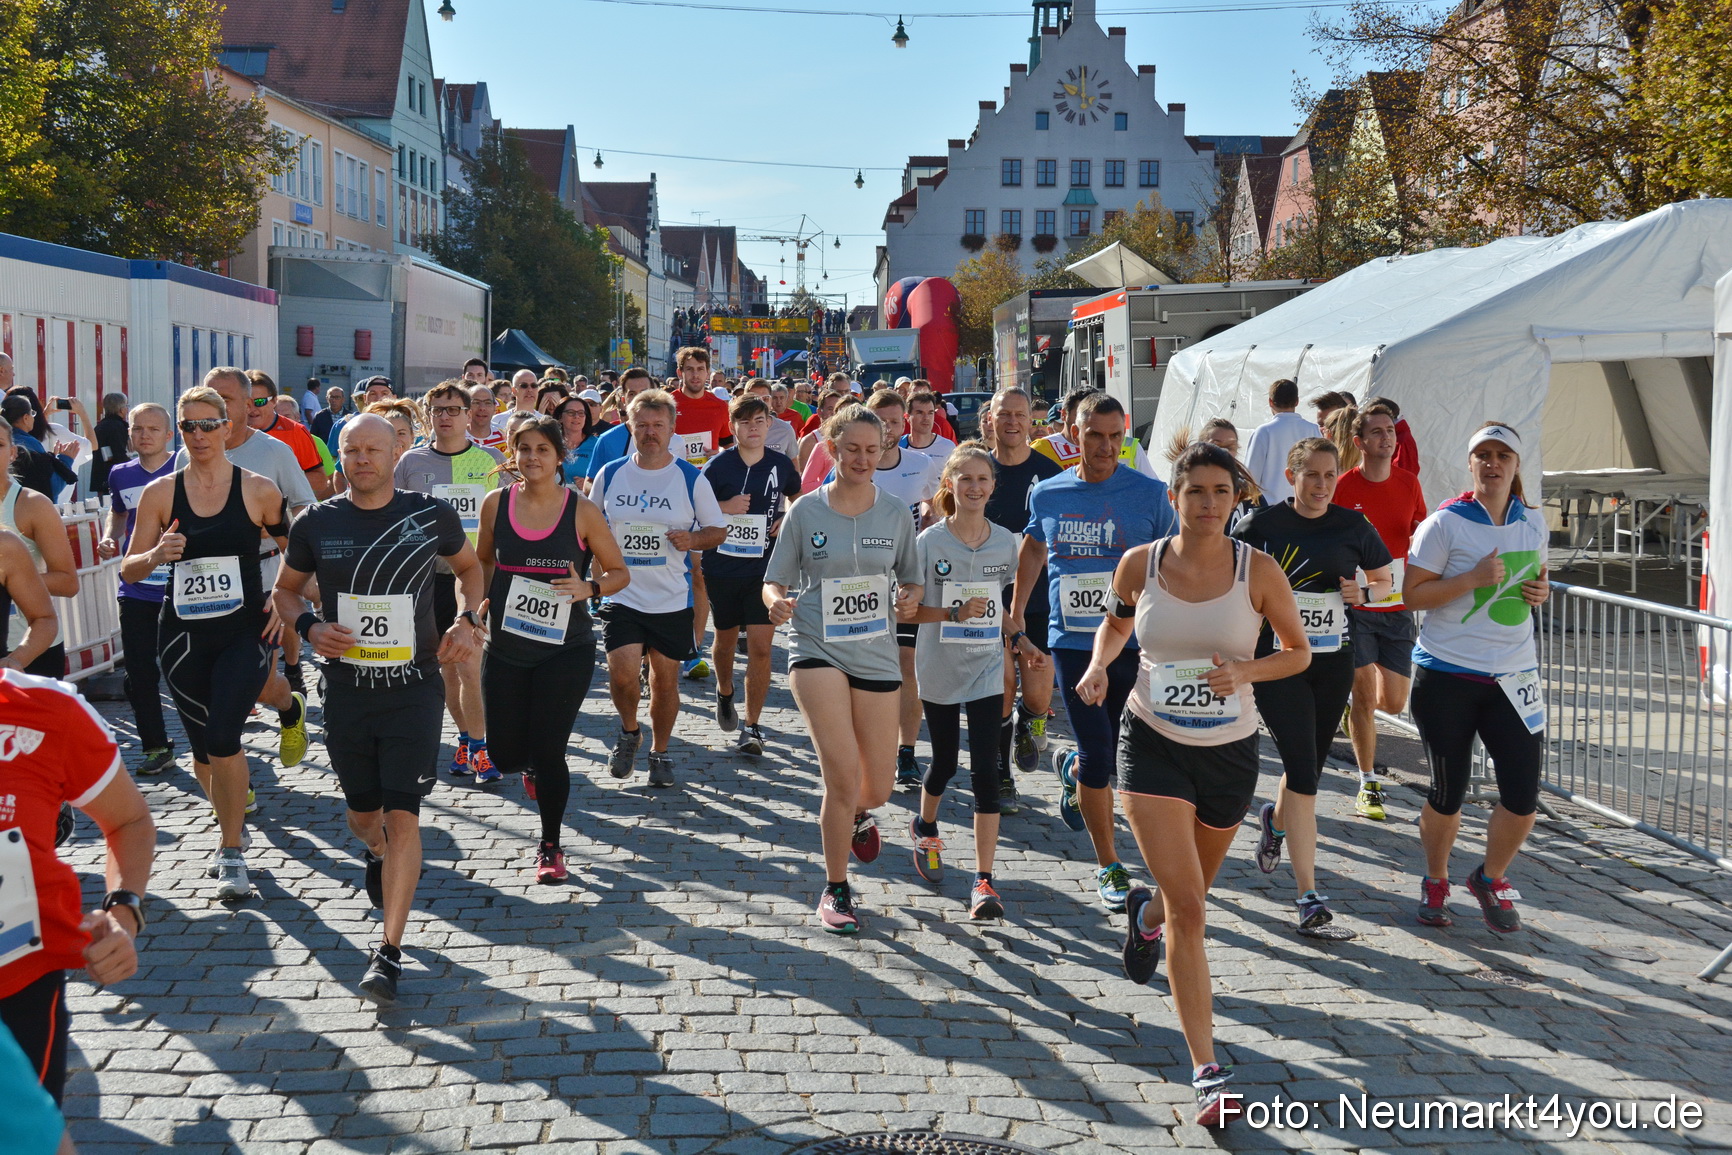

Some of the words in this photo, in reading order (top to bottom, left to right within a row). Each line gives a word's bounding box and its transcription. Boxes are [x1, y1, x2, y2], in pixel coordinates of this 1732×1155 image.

[742, 321, 776, 329] START
[443, 497, 476, 512] 091
[615, 492, 672, 511] SUSPA
[727, 524, 759, 540] 2385
[1059, 521, 1102, 536] TOUGH
[398, 534, 428, 542] Reebok
[624, 535, 660, 550] 2395
[862, 538, 893, 547] BOCK
[1057, 533, 1101, 545] MUDDER
[1070, 546, 1103, 557] FULL
[526, 558, 569, 567] OBSESSION
[983, 564, 1008, 574] BOCK
[184, 574, 231, 596] 2319
[833, 592, 878, 616] 2066
[1069, 590, 1107, 608] 302
[190, 603, 231, 613] Christiane
[358, 602, 391, 610] BOCK
[515, 594, 559, 620] 2081
[360, 616, 389, 637] 26
[520, 622, 547, 636] Kathrin
[848, 625, 868, 635] Anna
[963, 629, 984, 637] Carla
[360, 649, 389, 659] Daniel
[1164, 683, 1227, 707] 2254
[1169, 716, 1221, 728] Eva-Maria
